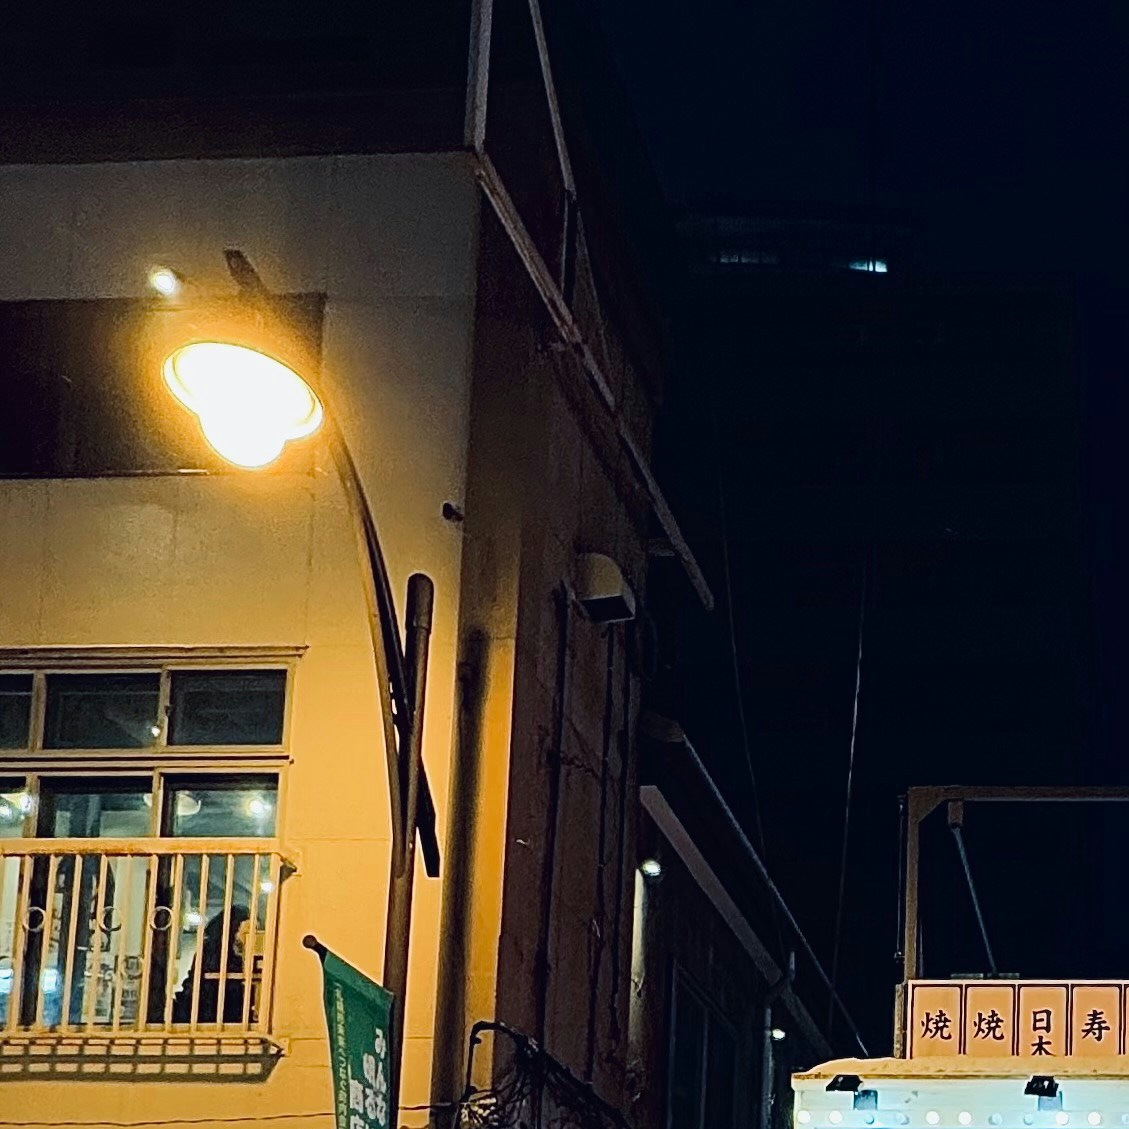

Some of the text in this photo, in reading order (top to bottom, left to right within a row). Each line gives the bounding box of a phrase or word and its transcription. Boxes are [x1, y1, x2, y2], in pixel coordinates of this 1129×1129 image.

[921, 1009, 952, 1041] 焼
[973, 1009, 1004, 1041] 焼
[1081, 1009, 1111, 1041] 寿
